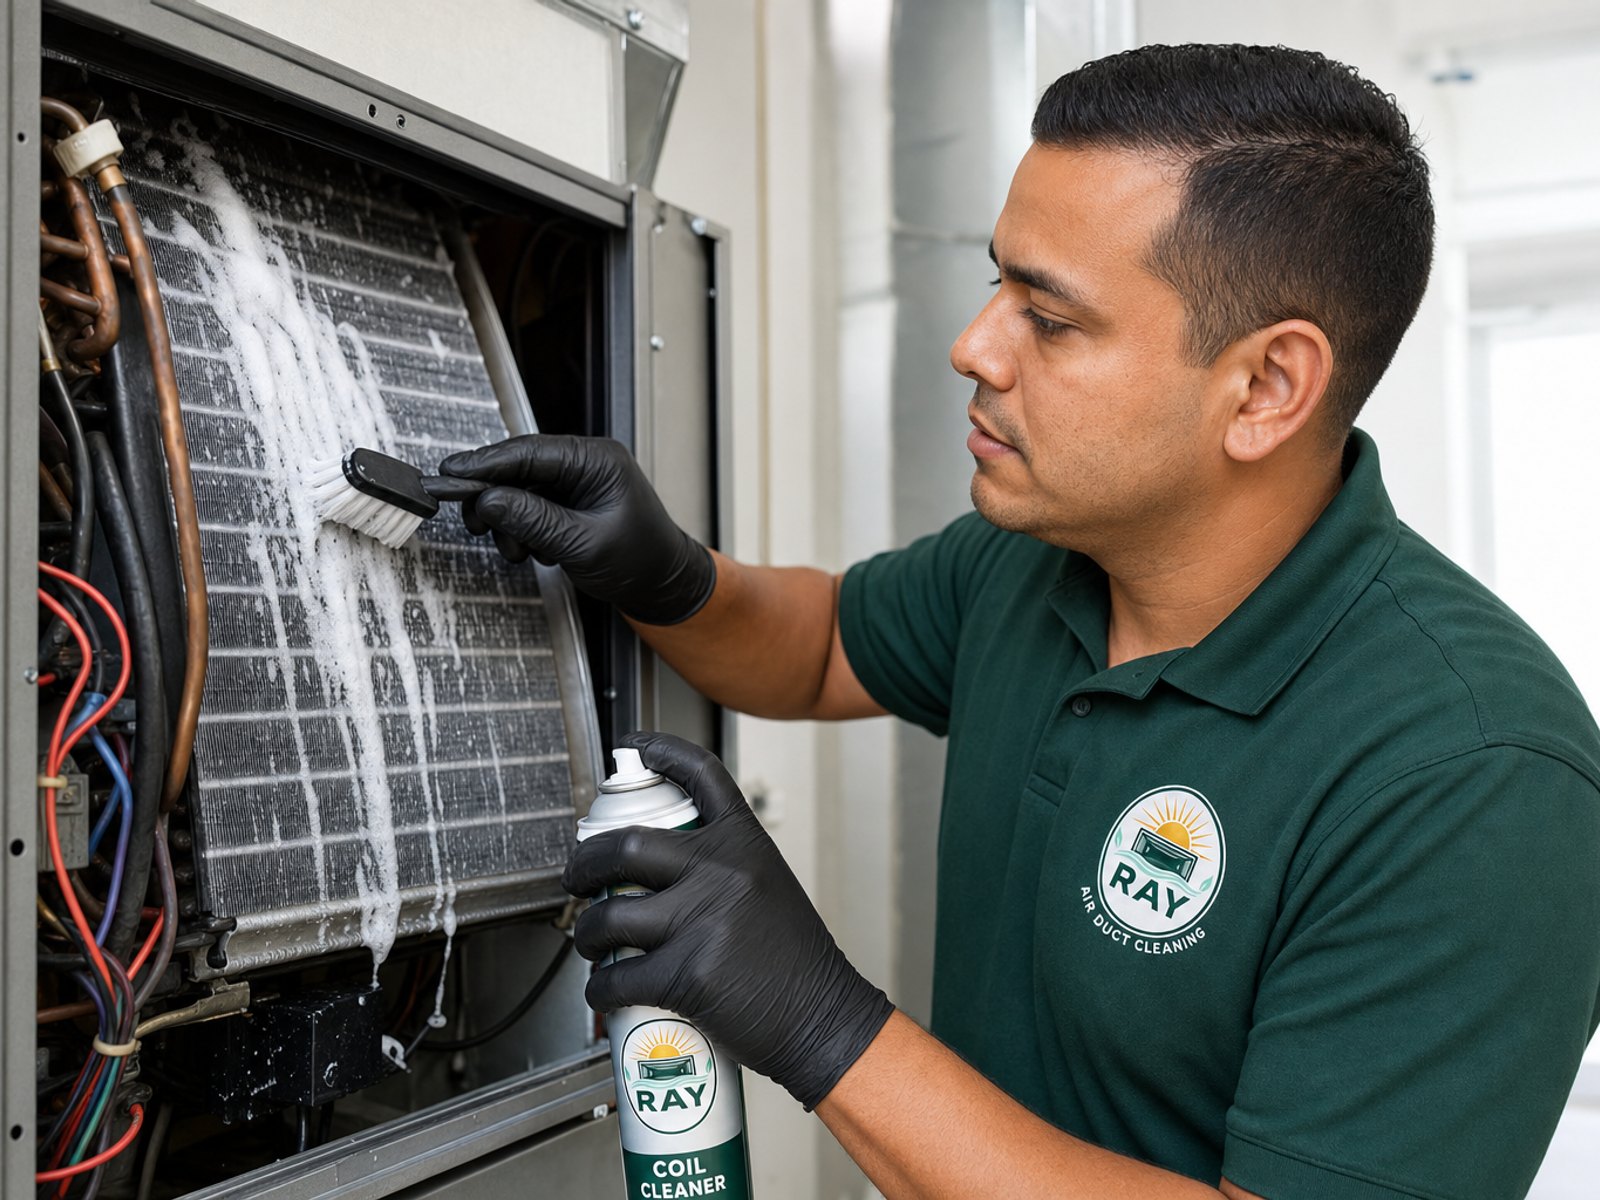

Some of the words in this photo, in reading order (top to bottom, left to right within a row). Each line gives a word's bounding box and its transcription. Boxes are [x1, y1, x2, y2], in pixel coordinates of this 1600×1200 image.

[1109, 862, 1190, 919] RAY
[1081, 886, 1095, 913] AIR
[1093, 914, 1131, 946] DUCT
[1134, 927, 1206, 954] CLEANING
[636, 1083, 707, 1112] RAY
[652, 1157, 707, 1178] COIL
[641, 1175, 726, 1199] CLEANER
